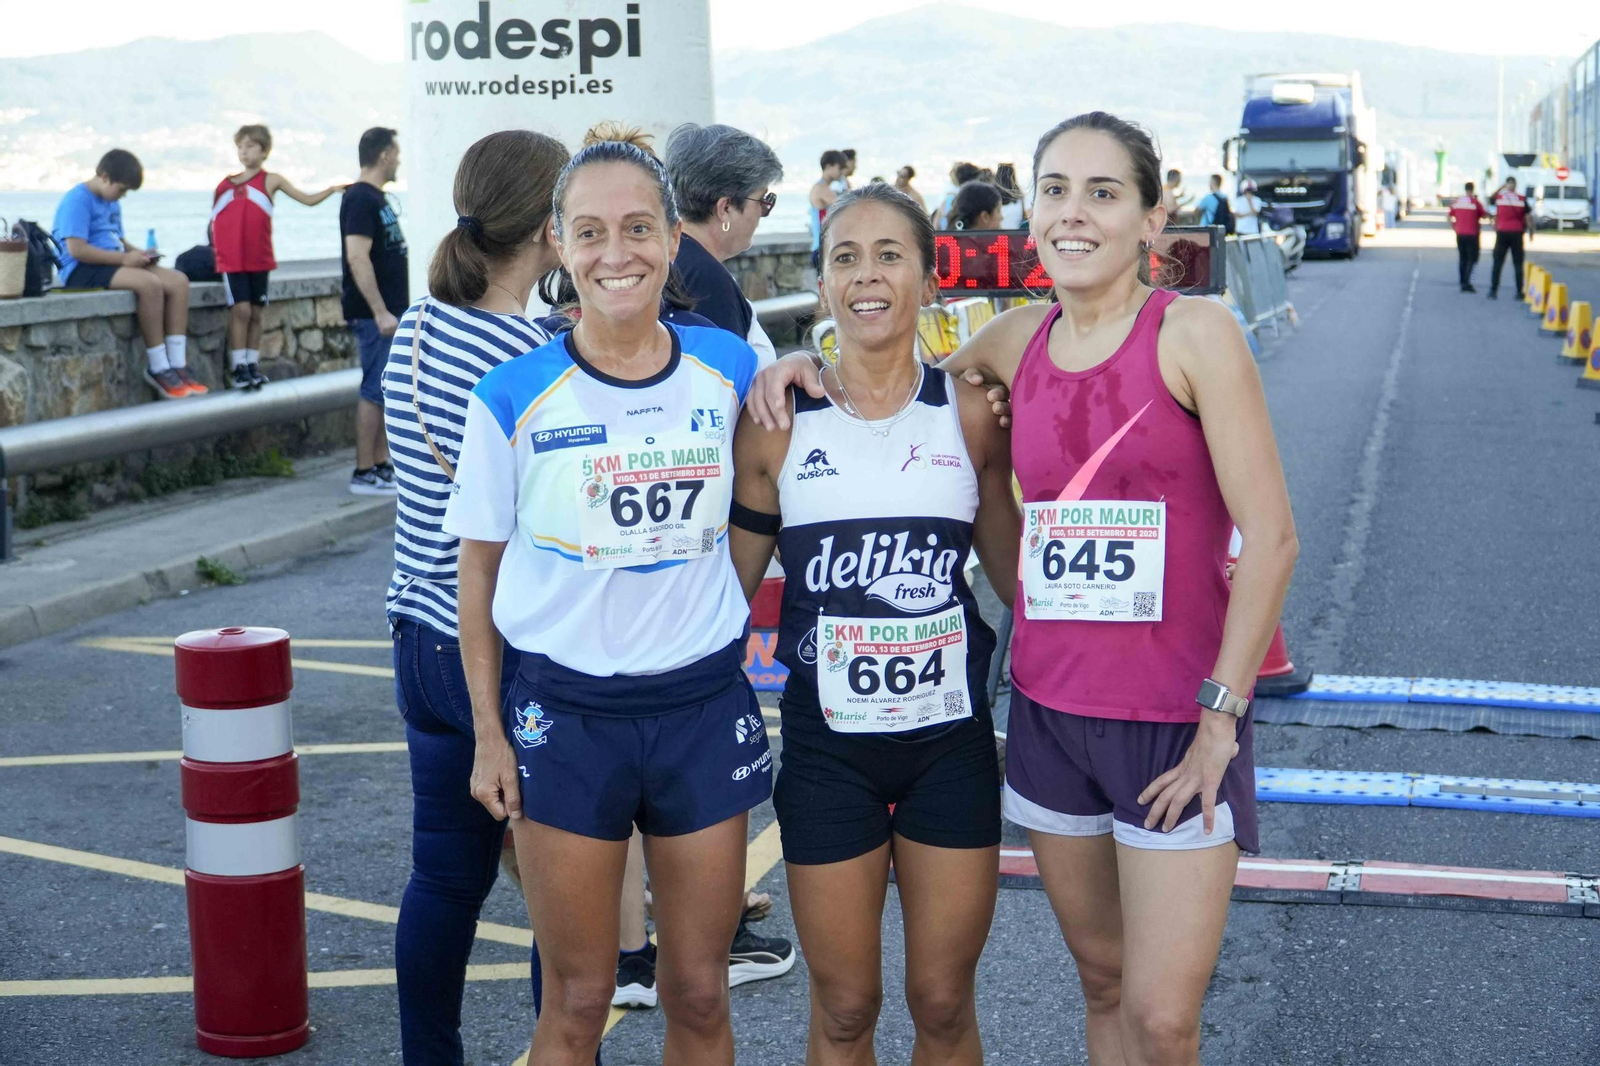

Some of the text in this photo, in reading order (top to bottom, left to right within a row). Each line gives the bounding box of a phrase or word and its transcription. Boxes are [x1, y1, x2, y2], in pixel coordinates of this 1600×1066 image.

[411, 1, 641, 74] rodespi
[425, 75, 613, 99] www.rodespi.es
[626, 407, 664, 416] NAFFTA
[554, 427, 603, 439] HYUNDAI
[582, 447, 720, 476] 5KM POR MAURI
[932, 459, 962, 469] DELIKIA
[616, 475, 637, 483] VIGO,
[649, 472, 659, 480] DE
[660, 469, 694, 479] SETEMBRO
[610, 480, 705, 527] 667
[1030, 508, 1161, 526] 5KM POR MAURI
[620, 528, 646, 536] OLALLA
[1051, 529, 1066, 537] VIGO,
[1087, 529, 1125, 537] SETEMBRO
[597, 544, 633, 556] Marisé
[806, 531, 958, 592] delikia
[1042, 539, 1136, 582] 645
[895, 582, 936, 600] fresh
[825, 613, 962, 642] 5KM POR MAURI
[857, 645, 877, 653] VIGO,
[880, 645, 889, 653] 13
[891, 645, 900, 653] DE
[901, 641, 937, 653] SETEMBRO
[847, 648, 946, 695] 664
[832, 711, 867, 721] Marisé
